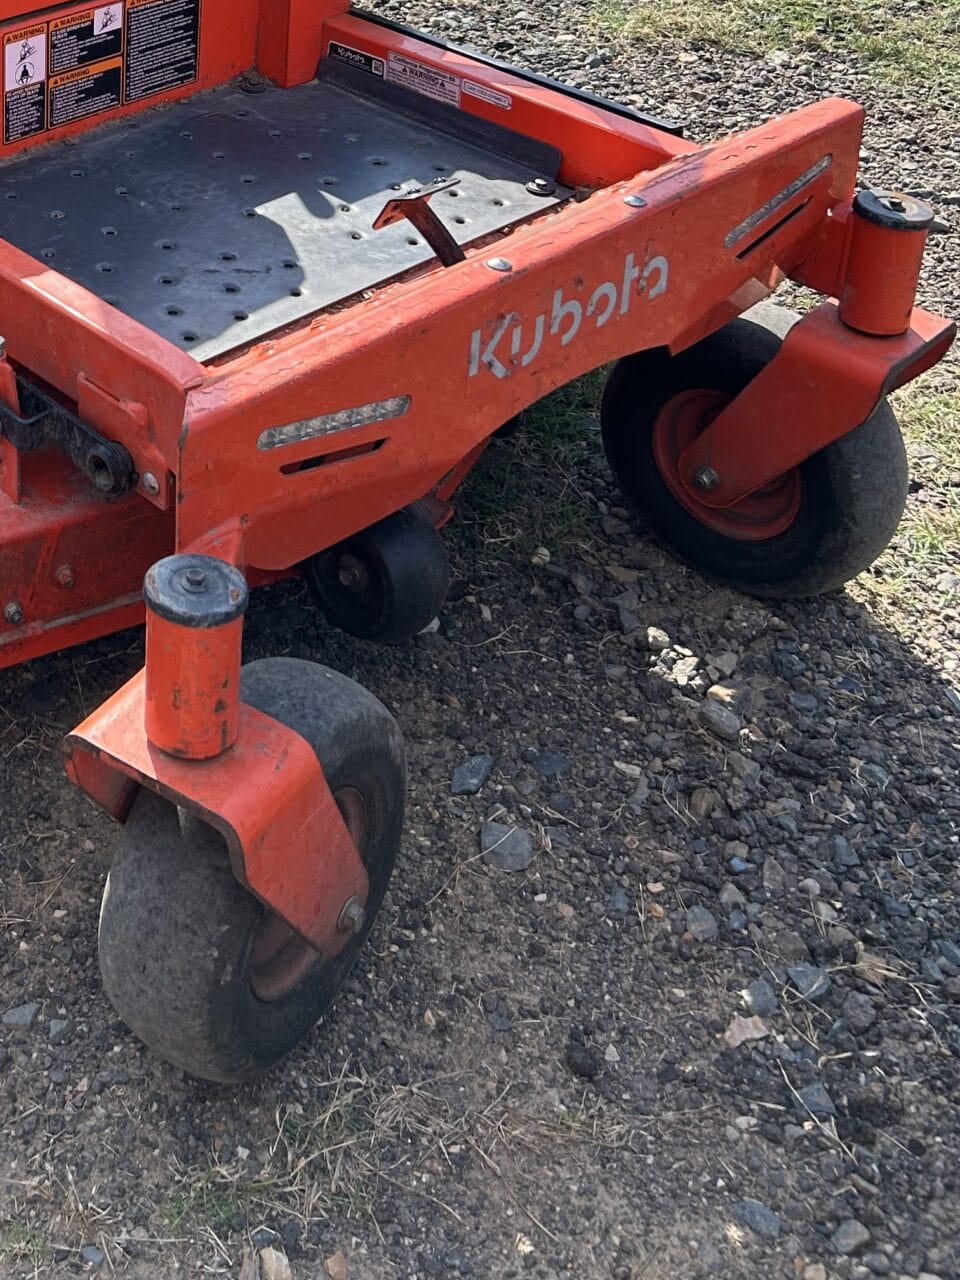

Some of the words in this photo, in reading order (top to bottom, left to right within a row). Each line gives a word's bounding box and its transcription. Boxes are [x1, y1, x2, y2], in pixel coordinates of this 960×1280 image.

[59, 12, 91, 26] WARNING
[12, 26, 45, 40] WARNING
[337, 46, 365, 64] Kubota
[59, 68, 90, 84] WARNING
[468, 252, 669, 379] Kubota
